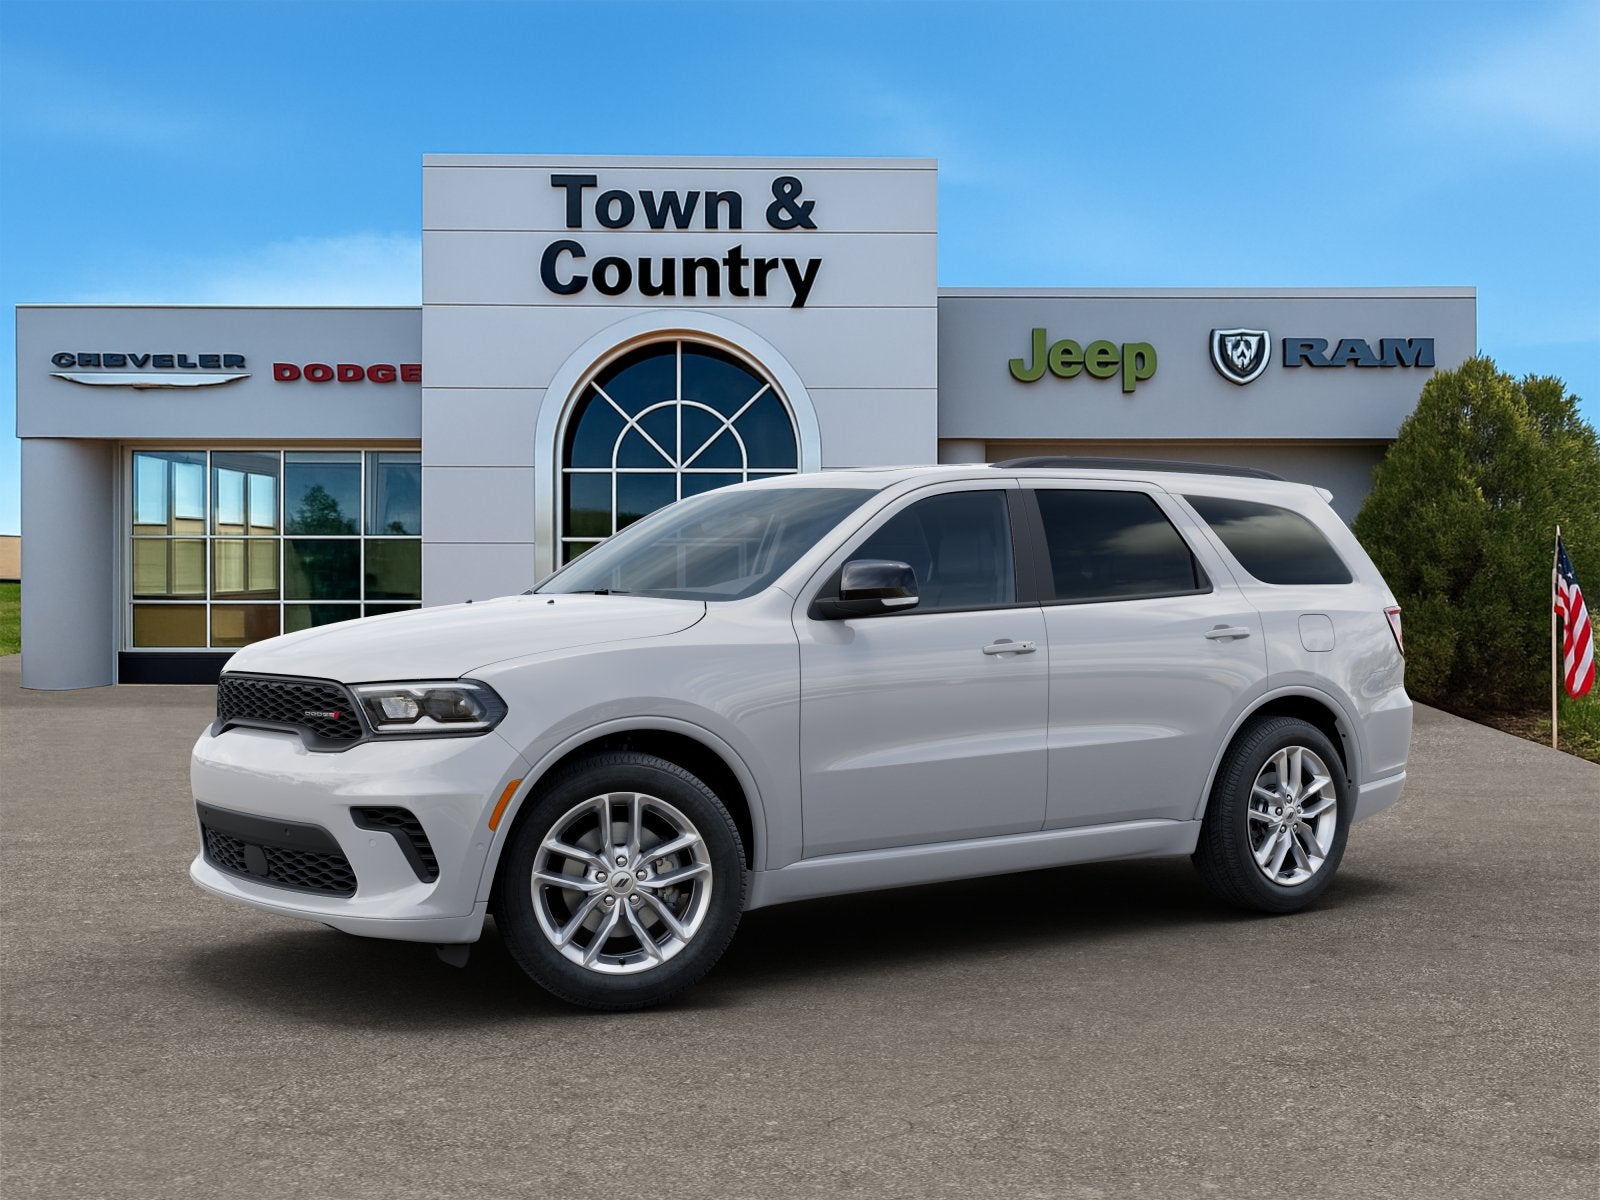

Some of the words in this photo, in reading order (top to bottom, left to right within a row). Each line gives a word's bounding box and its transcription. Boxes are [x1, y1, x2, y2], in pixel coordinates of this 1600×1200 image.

[551, 174, 742, 229] Town
[766, 176, 817, 230] &
[540, 239, 822, 308] Country
[273, 363, 422, 383] DODGE
[1009, 328, 1157, 393] Jeep
[1283, 337, 1435, 368] RAM
